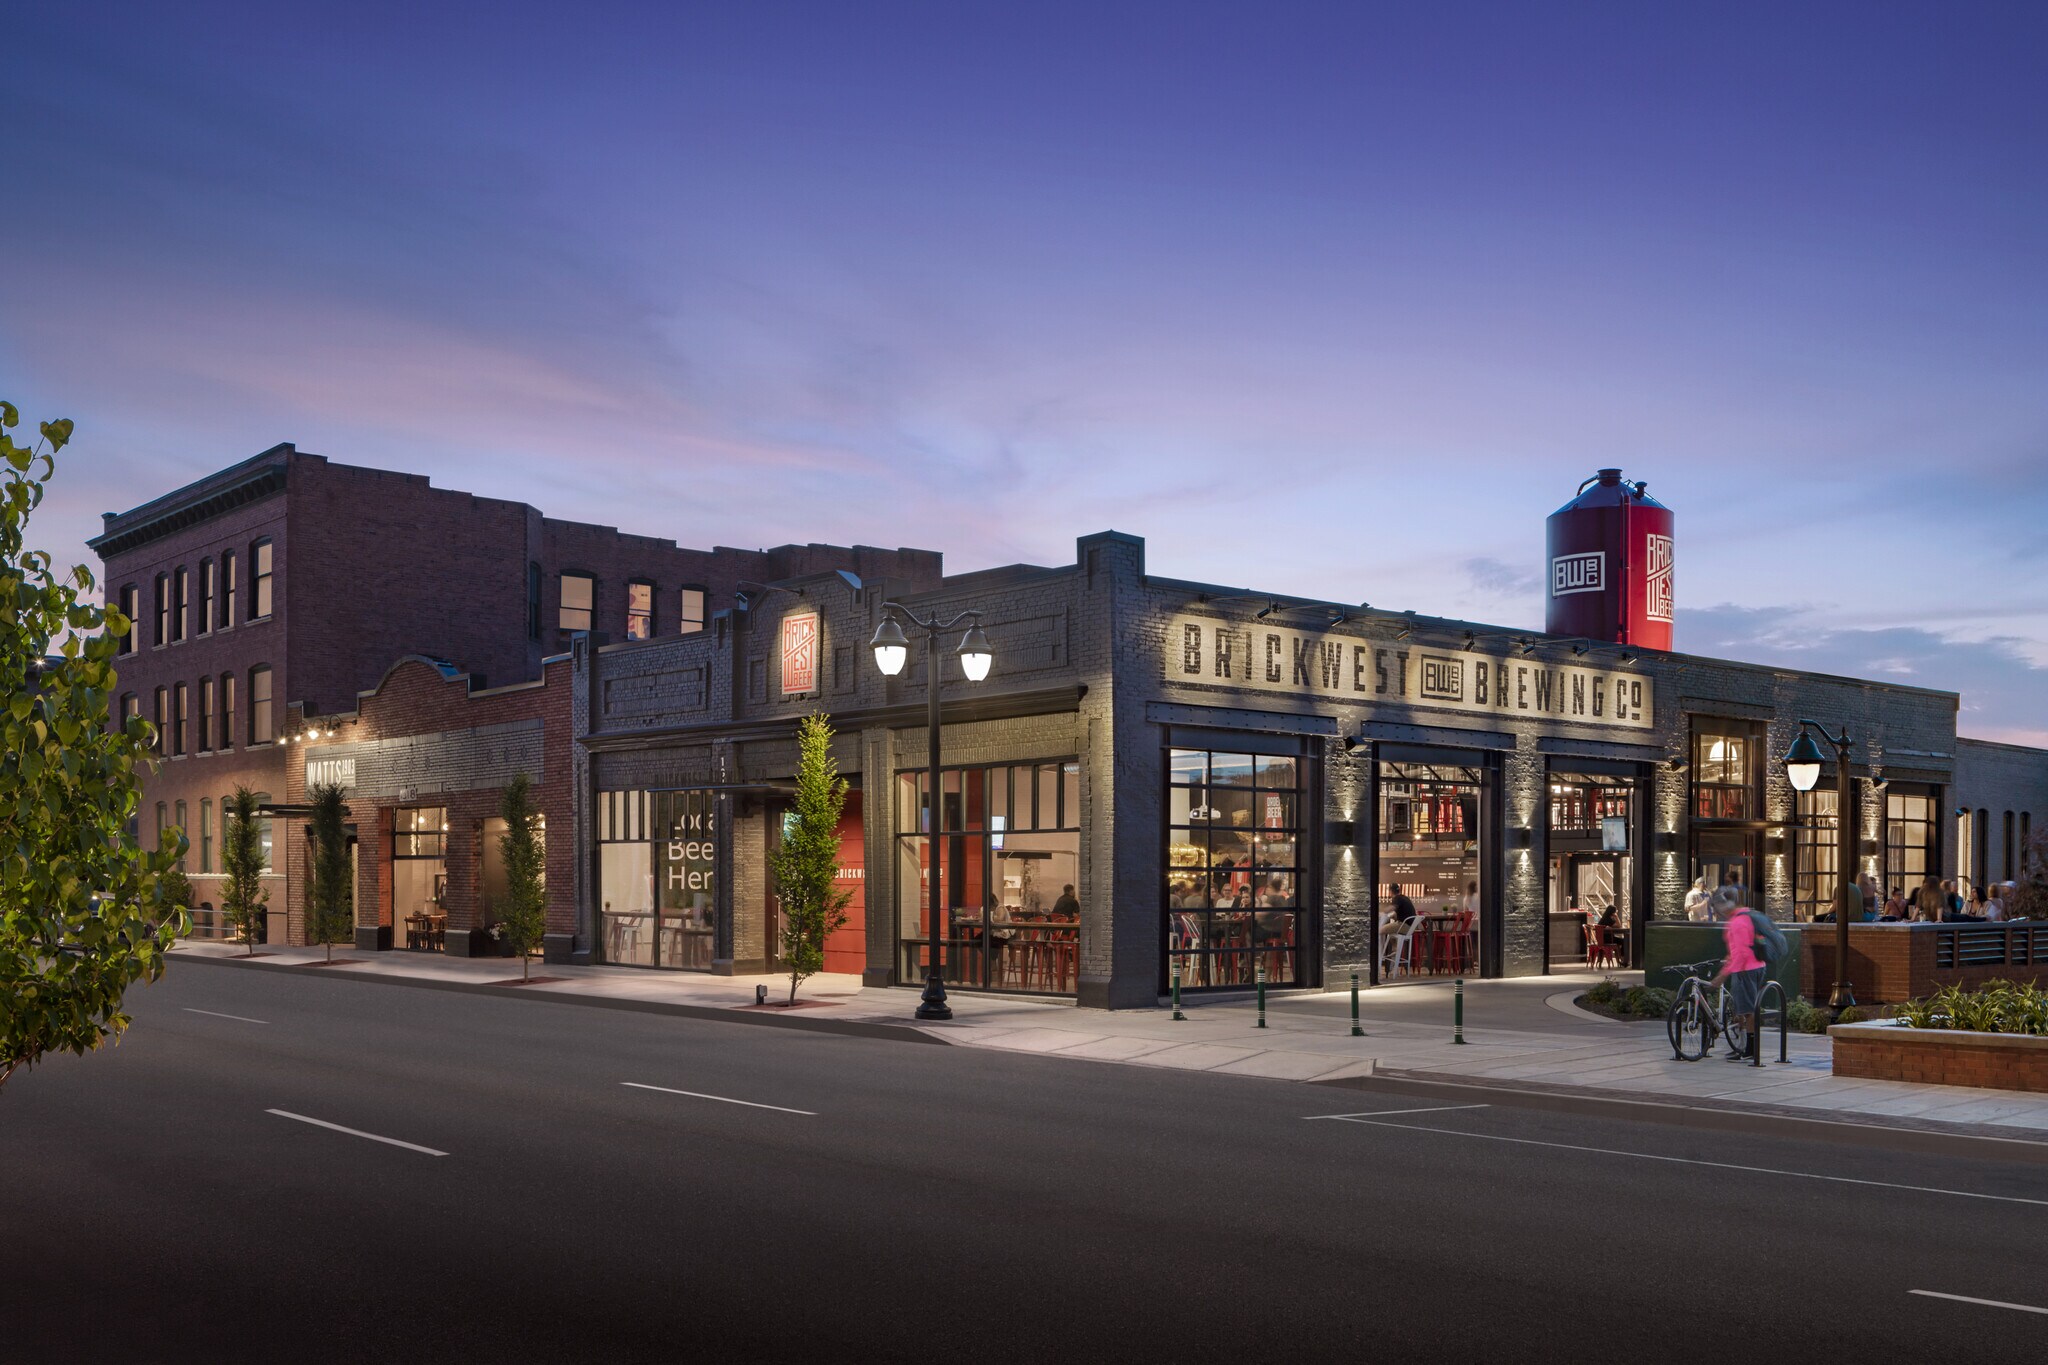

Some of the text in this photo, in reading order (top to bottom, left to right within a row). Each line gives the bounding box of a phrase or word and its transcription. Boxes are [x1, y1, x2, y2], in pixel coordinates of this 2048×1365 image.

[1647, 534, 1674, 576] BRIC
[1647, 567, 1674, 616] WES
[1660, 598, 1674, 618] BEE
[784, 620, 815, 654] BRICK
[784, 639, 815, 687] WEST
[793, 670, 812, 686] BEER
[1184, 623, 1410, 696] BRICKWEST
[1475, 661, 1604, 717] BREWING
[307, 760, 342, 786] WATTS
[668, 836, 714, 861] Bee
[668, 866, 714, 890] Her
